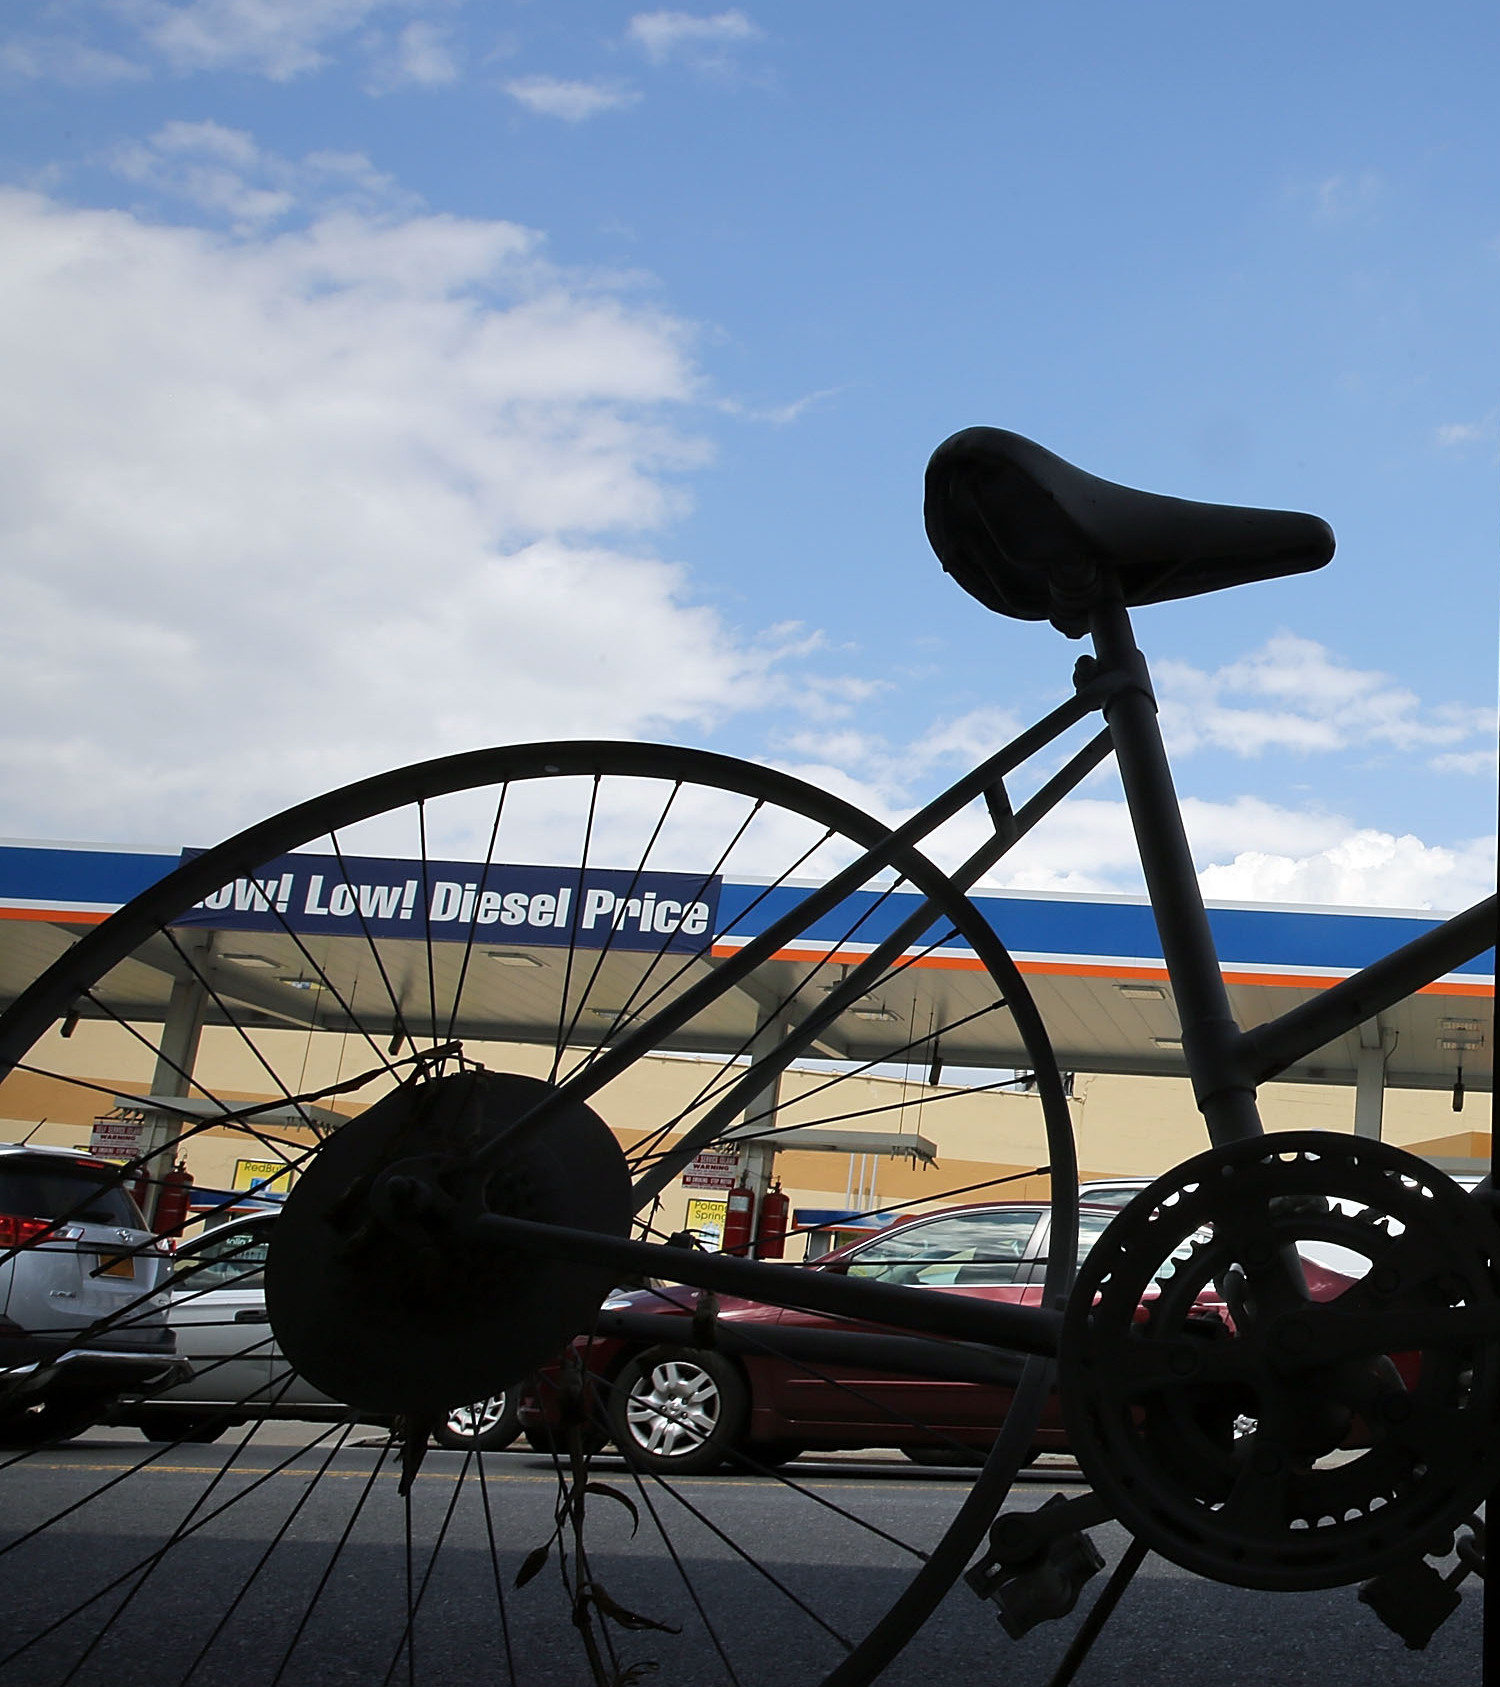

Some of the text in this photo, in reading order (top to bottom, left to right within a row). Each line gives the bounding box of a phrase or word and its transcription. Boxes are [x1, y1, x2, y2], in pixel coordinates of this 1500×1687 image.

[192, 873, 710, 935] ow! Low! Diesel Price
[244, 1162, 284, 1173] RedBu
